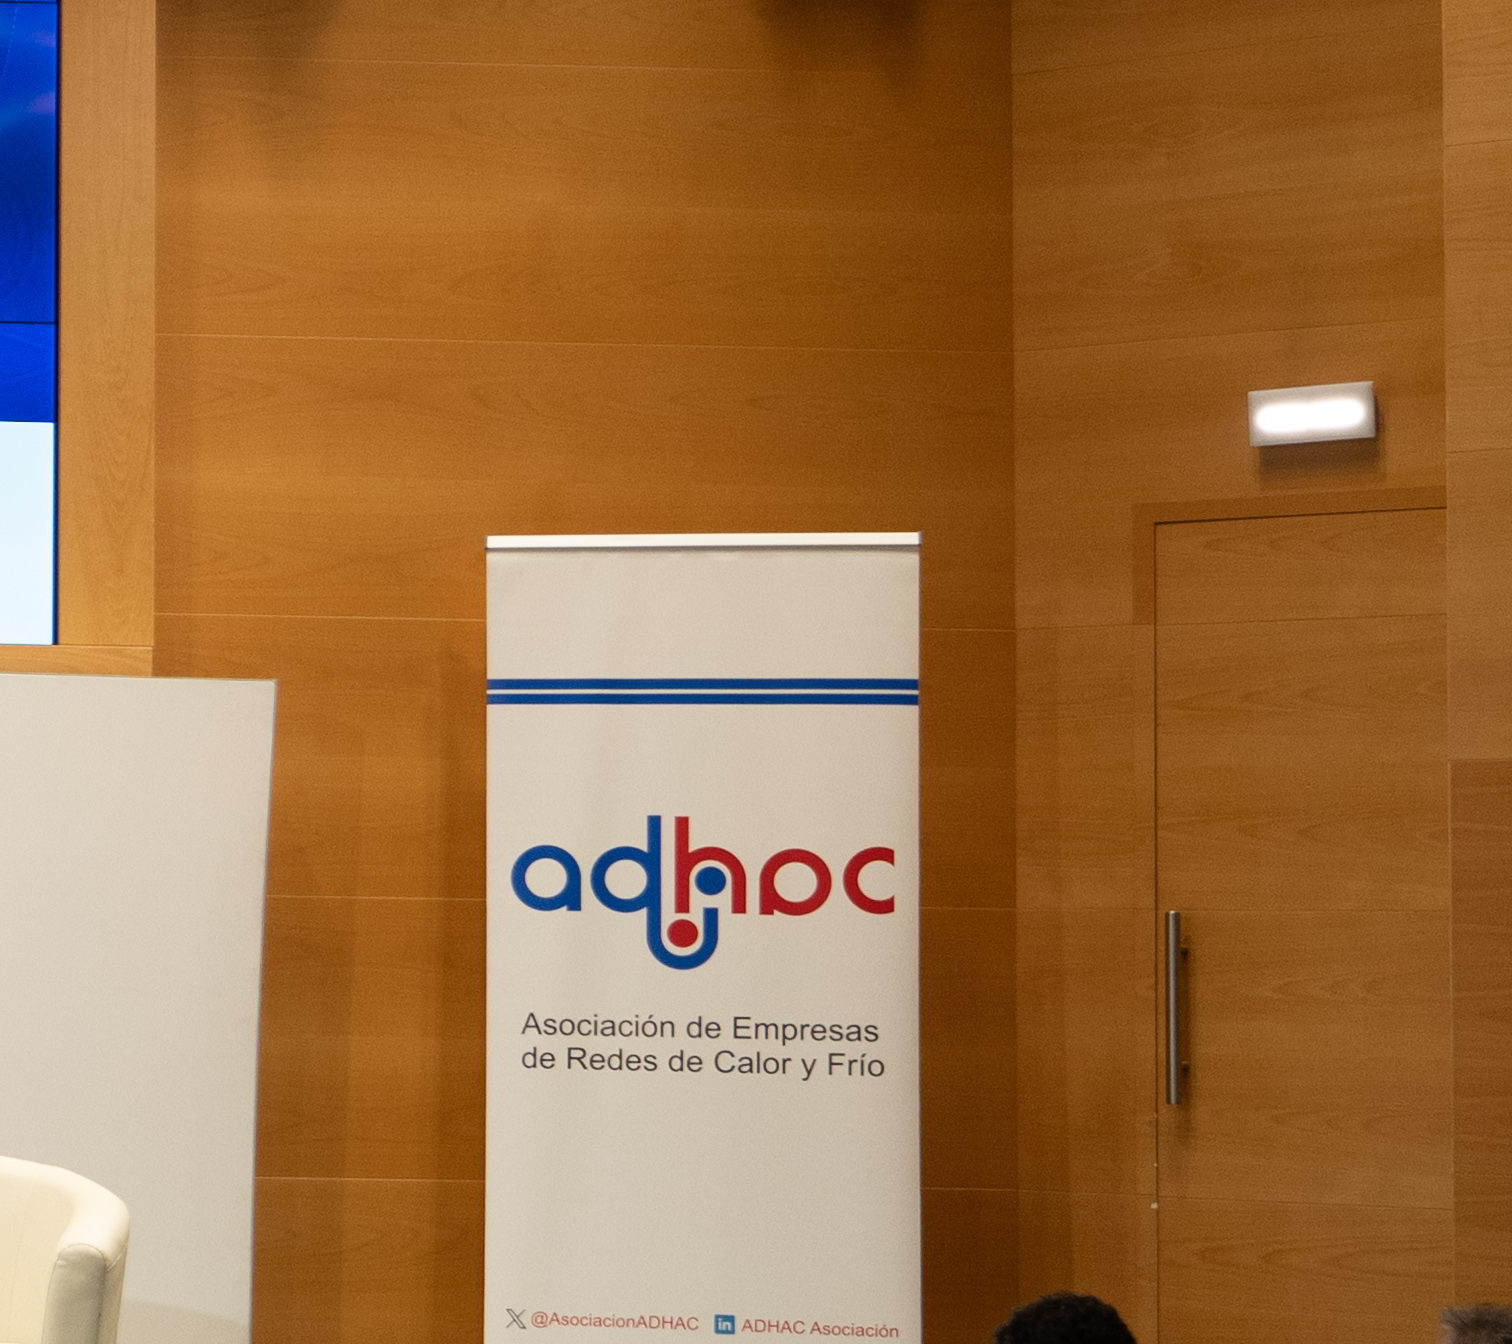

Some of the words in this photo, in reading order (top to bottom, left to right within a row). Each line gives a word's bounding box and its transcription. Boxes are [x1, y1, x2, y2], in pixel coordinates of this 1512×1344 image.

[521, 1013, 675, 1038] Asociación
[686, 1016, 721, 1040] de
[733, 1017, 879, 1046] Empresas
[522, 1048, 555, 1069] de
[567, 1048, 658, 1072] Redes
[668, 1051, 703, 1073] de
[714, 1051, 792, 1075] Calor
[801, 1058, 816, 1081] y
[828, 1053, 885, 1077] Frío
[531, 1311, 700, 1331] @AsociacionADHAC
[741, 1319, 805, 1335] ADHAC
[810, 1321, 899, 1338] Asociación
